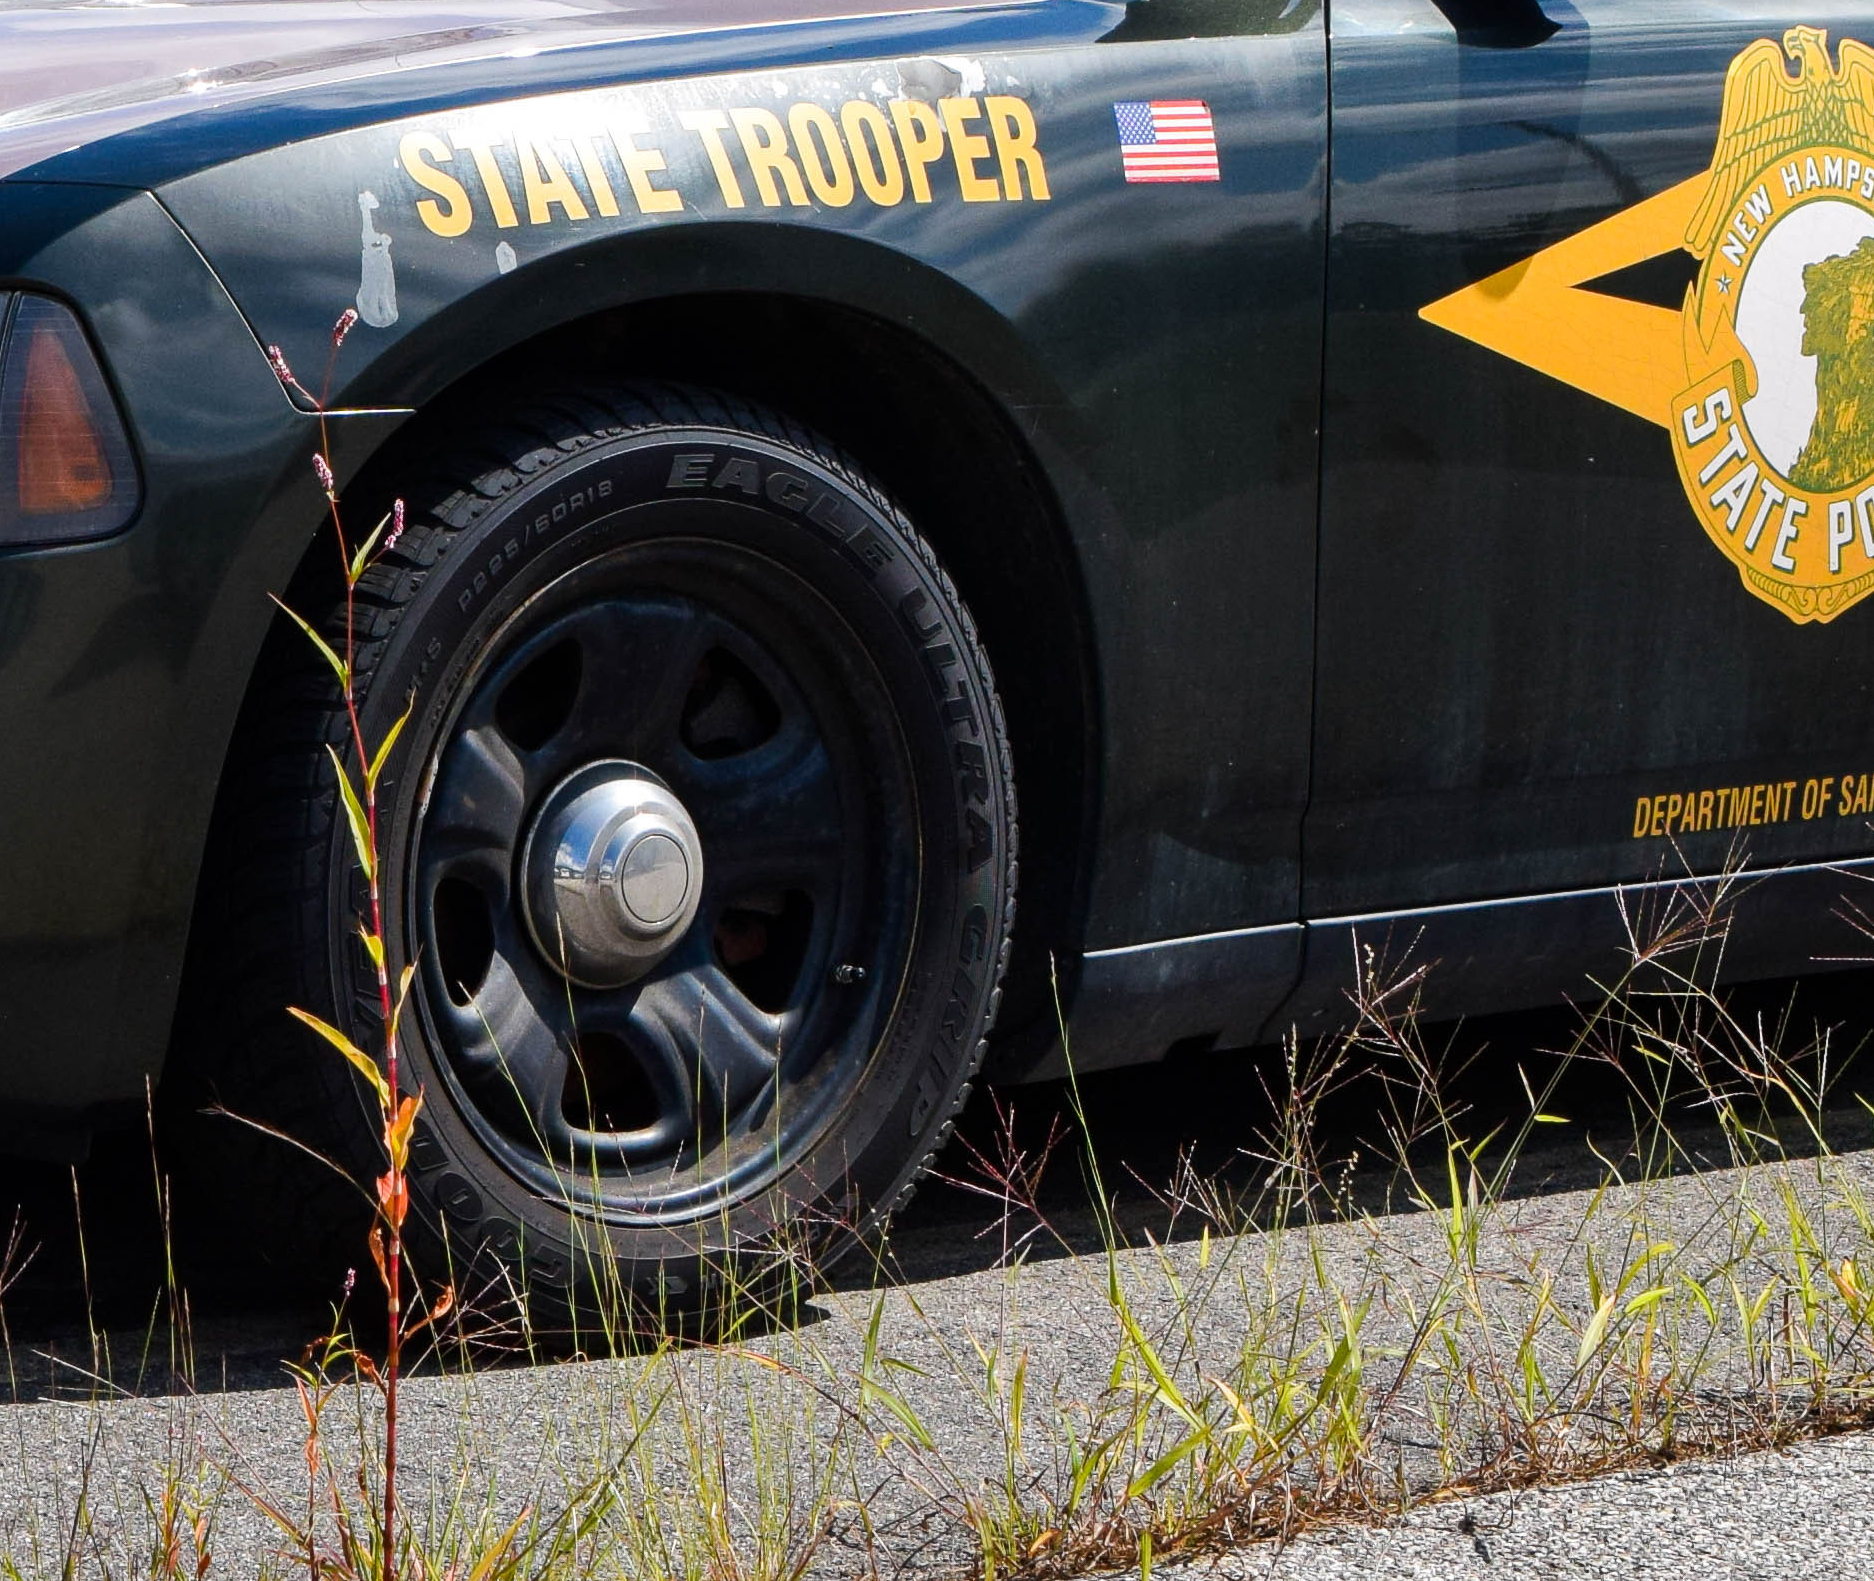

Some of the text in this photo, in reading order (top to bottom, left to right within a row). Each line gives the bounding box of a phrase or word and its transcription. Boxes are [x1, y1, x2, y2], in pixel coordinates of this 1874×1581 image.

[398, 96, 1051, 238] STATE TROOPER
[1721, 184, 1772, 266] NEW
[455, 478, 615, 616] P225/60R18
[1681, 386, 1808, 571] STATE
[665, 452, 995, 1137] EAGLE ULTRA GRIP
[1633, 781, 1797, 838] DEPARTMENT
[1801, 778, 1834, 820] OF
